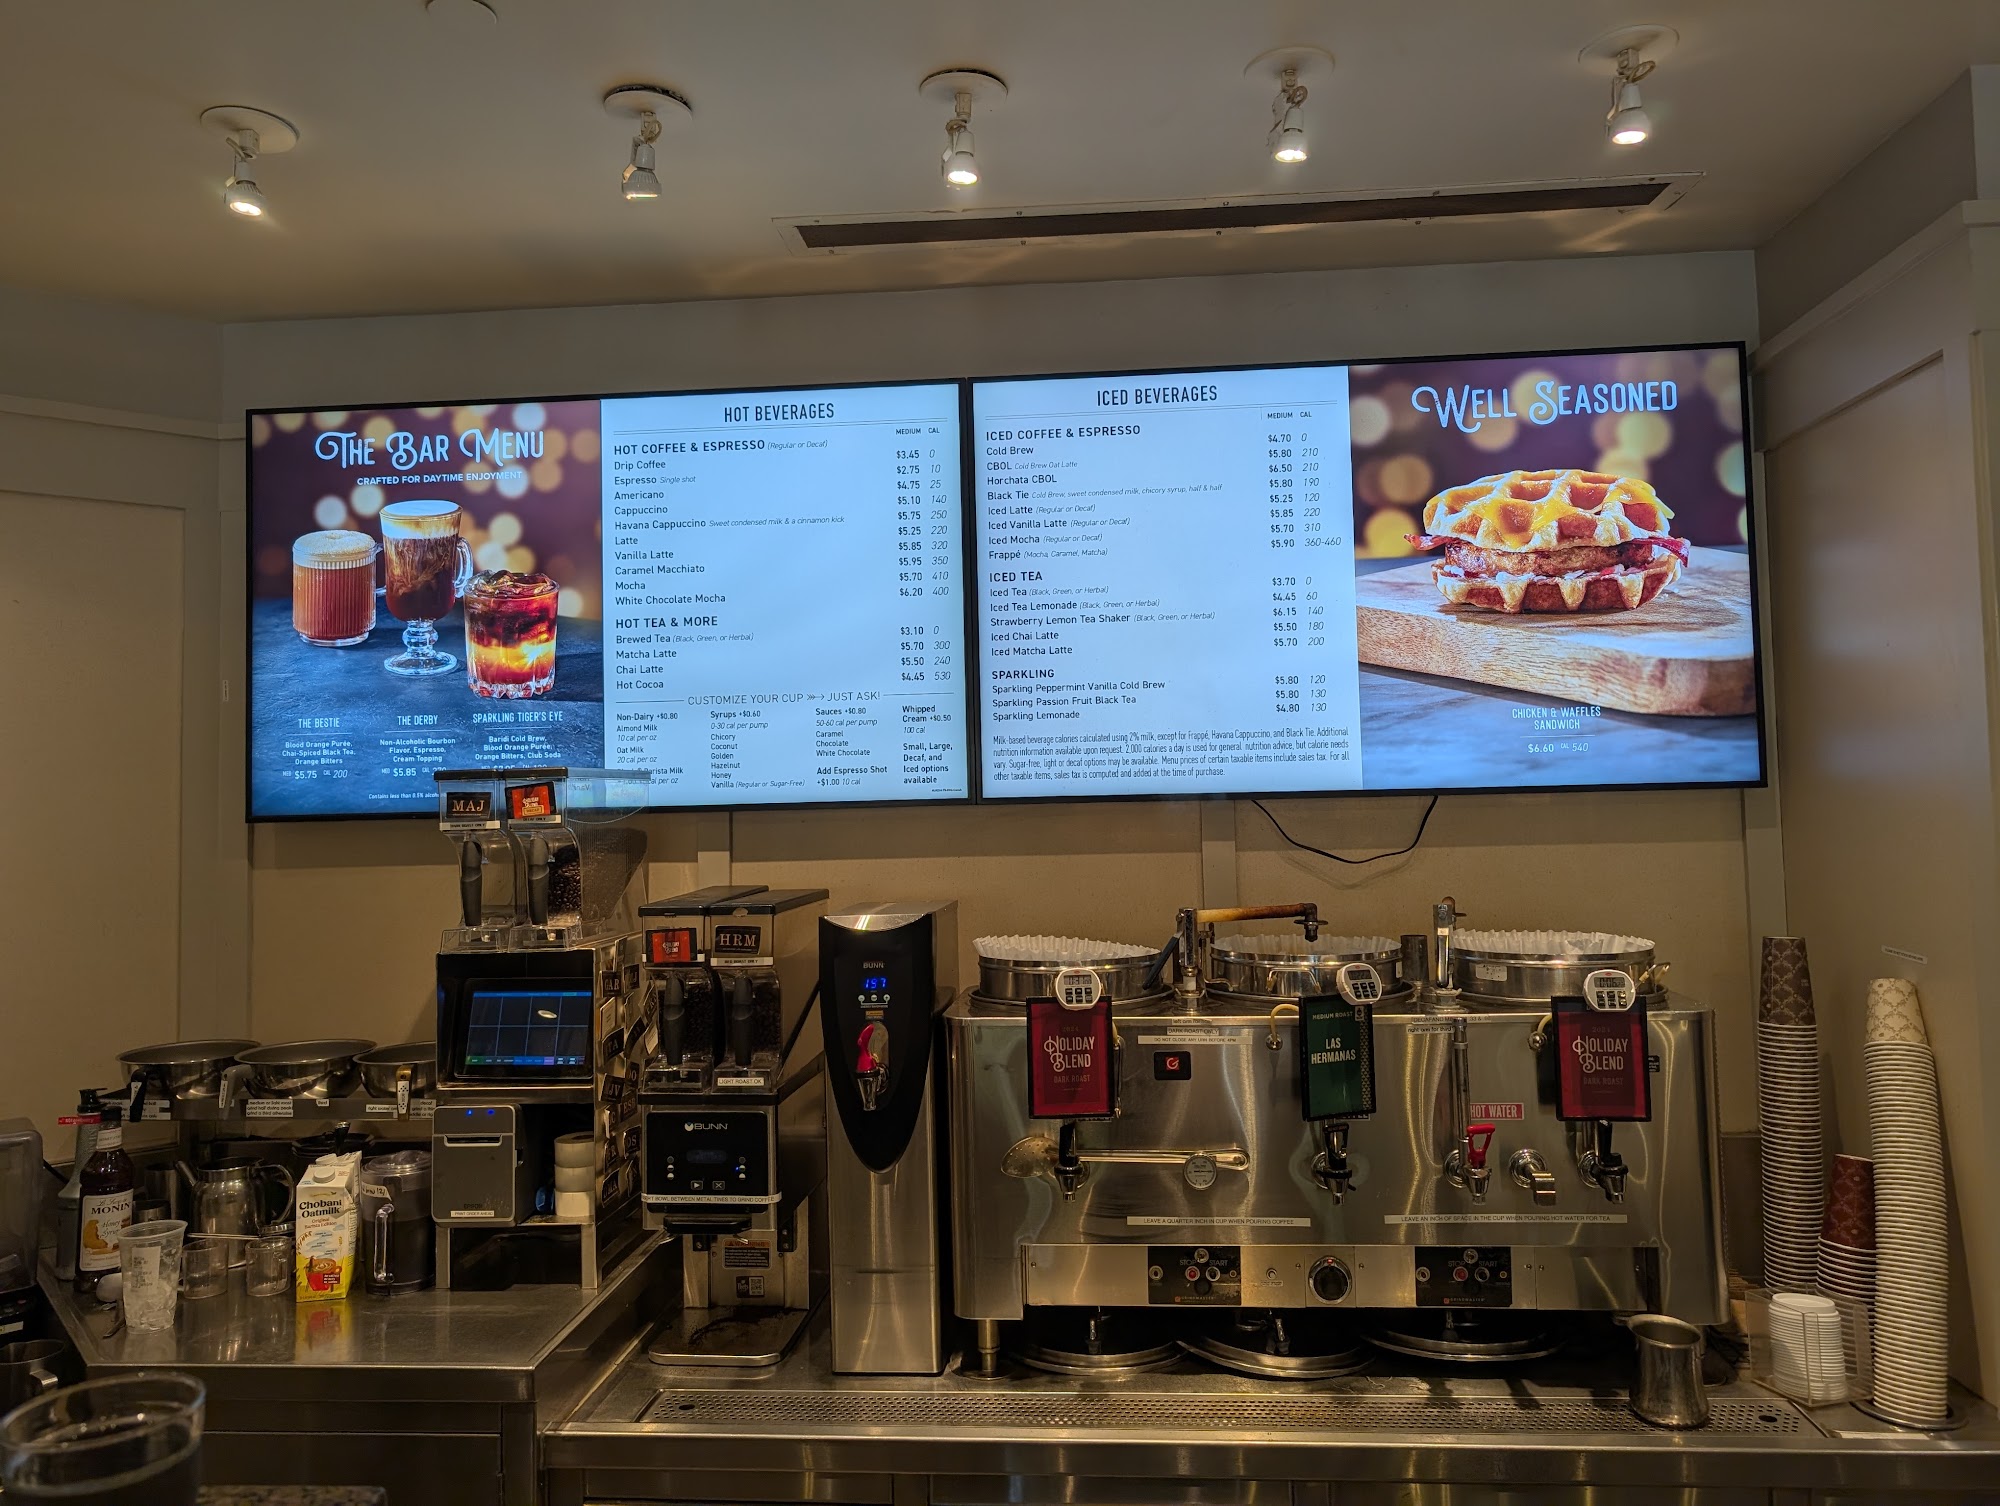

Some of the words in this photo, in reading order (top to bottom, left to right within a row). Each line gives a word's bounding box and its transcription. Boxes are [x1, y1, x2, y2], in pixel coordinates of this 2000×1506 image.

[1097, 389, 1127, 406] ICED
[1135, 385, 1216, 404] BEVERAGES
[724, 406, 749, 422] HOT
[755, 402, 833, 420] BEVERAGES
[1412, 384, 1516, 434] WELL
[1529, 380, 1678, 425] SEASONED
[986, 430, 1012, 440] ICED
[1017, 428, 1061, 439] COFFEE
[1066, 428, 1073, 437] &
[1078, 425, 1140, 436] ESPRESSO
[1268, 433, 1291, 442] $4.70
[1301, 433, 1307, 441] 0
[315, 431, 375, 469] THE
[385, 431, 449, 471] BAR
[459, 428, 544, 467] MENU
[614, 444, 637, 455] HOT
[641, 442, 685, 453] COFFEE
[690, 442, 698, 451] &
[703, 439, 764, 451] ESPRESSO
[986, 446, 1006, 455] Cold
[1010, 446, 1033, 454] Brew
[896, 449, 919, 459] $3.45
[929, 449, 935, 458] 0
[614, 461, 633, 471] Drip
[636, 460, 665, 469] Coffee
[896, 465, 919, 474] $2.75
[931, 464, 940, 473] 10
[1268, 463, 1292, 472] $6.50
[1302, 462, 1318, 471] 210
[357, 477, 399, 485] CRAFTED
[402, 475, 420, 483] FOR
[423, 473, 463, 482] DAYTIME
[466, 471, 522, 482] ENJOYMENT
[614, 476, 656, 486] Espresso
[987, 476, 1028, 485] Horchata
[1032, 474, 1057, 483] CBOL
[897, 480, 920, 489] $4.75
[930, 479, 941, 488] 25
[614, 490, 664, 500] Americano
[897, 495, 920, 504] $5.10
[932, 494, 946, 503] 140
[614, 505, 667, 516] Cappuccino
[990, 572, 1015, 582] ICED
[1020, 571, 1042, 580] TEA
[616, 618, 639, 628] HOT
[643, 618, 666, 627] TEA
[670, 617, 678, 626] &
[683, 616, 717, 626] MORE
[1273, 622, 1296, 631] $5.50
[1309, 621, 1324, 630] 180
[991, 632, 1009, 641] Iced
[1012, 631, 1032, 640] Chai
[992, 668, 1054, 679] SPARKLING
[688, 694, 746, 705] CUSTOMIZE
[750, 694, 778, 703] YOUR
[781, 693, 803, 702] CUP
[1276, 703, 1299, 712] $4.80
[1311, 702, 1326, 711] 130
[1512, 708, 1547, 719] CHICKEN
[1551, 708, 1558, 718] &
[1561, 706, 1601, 717] WAFFLES
[396, 715, 411, 725] THE
[413, 714, 437, 725] DERBY
[472, 711, 514, 723] SPARKLING
[517, 711, 546, 721] TIGER'S
[549, 710, 563, 722] EYE
[992, 711, 1033, 722] Sparkling
[1036, 710, 1079, 719] Lemonade
[297, 718, 311, 728] THE
[314, 717, 339, 727] BESTIE
[1534, 719, 1580, 730] SANDWICH
[1528, 744, 1554, 753] $6.60
[1572, 743, 1589, 752] 540
[294, 757, 318, 765] Orange
[392, 754, 414, 763] Cream
[294, 770, 317, 779] $5.75
[393, 767, 416, 776] $5.85
[452, 800, 484, 811] MAJ
[719, 933, 756, 946] HRM
[1325, 1038, 1341, 1049] LAS
[1311, 1050, 1356, 1064] HERMANAS
[1470, 1104, 1486, 1119] HOT
[1489, 1104, 1518, 1118] WATER
[91, 1202, 131, 1214] MONIN
[299, 1199, 342, 1210] Chobani
[302, 1207, 340, 1218] Oatmilk
